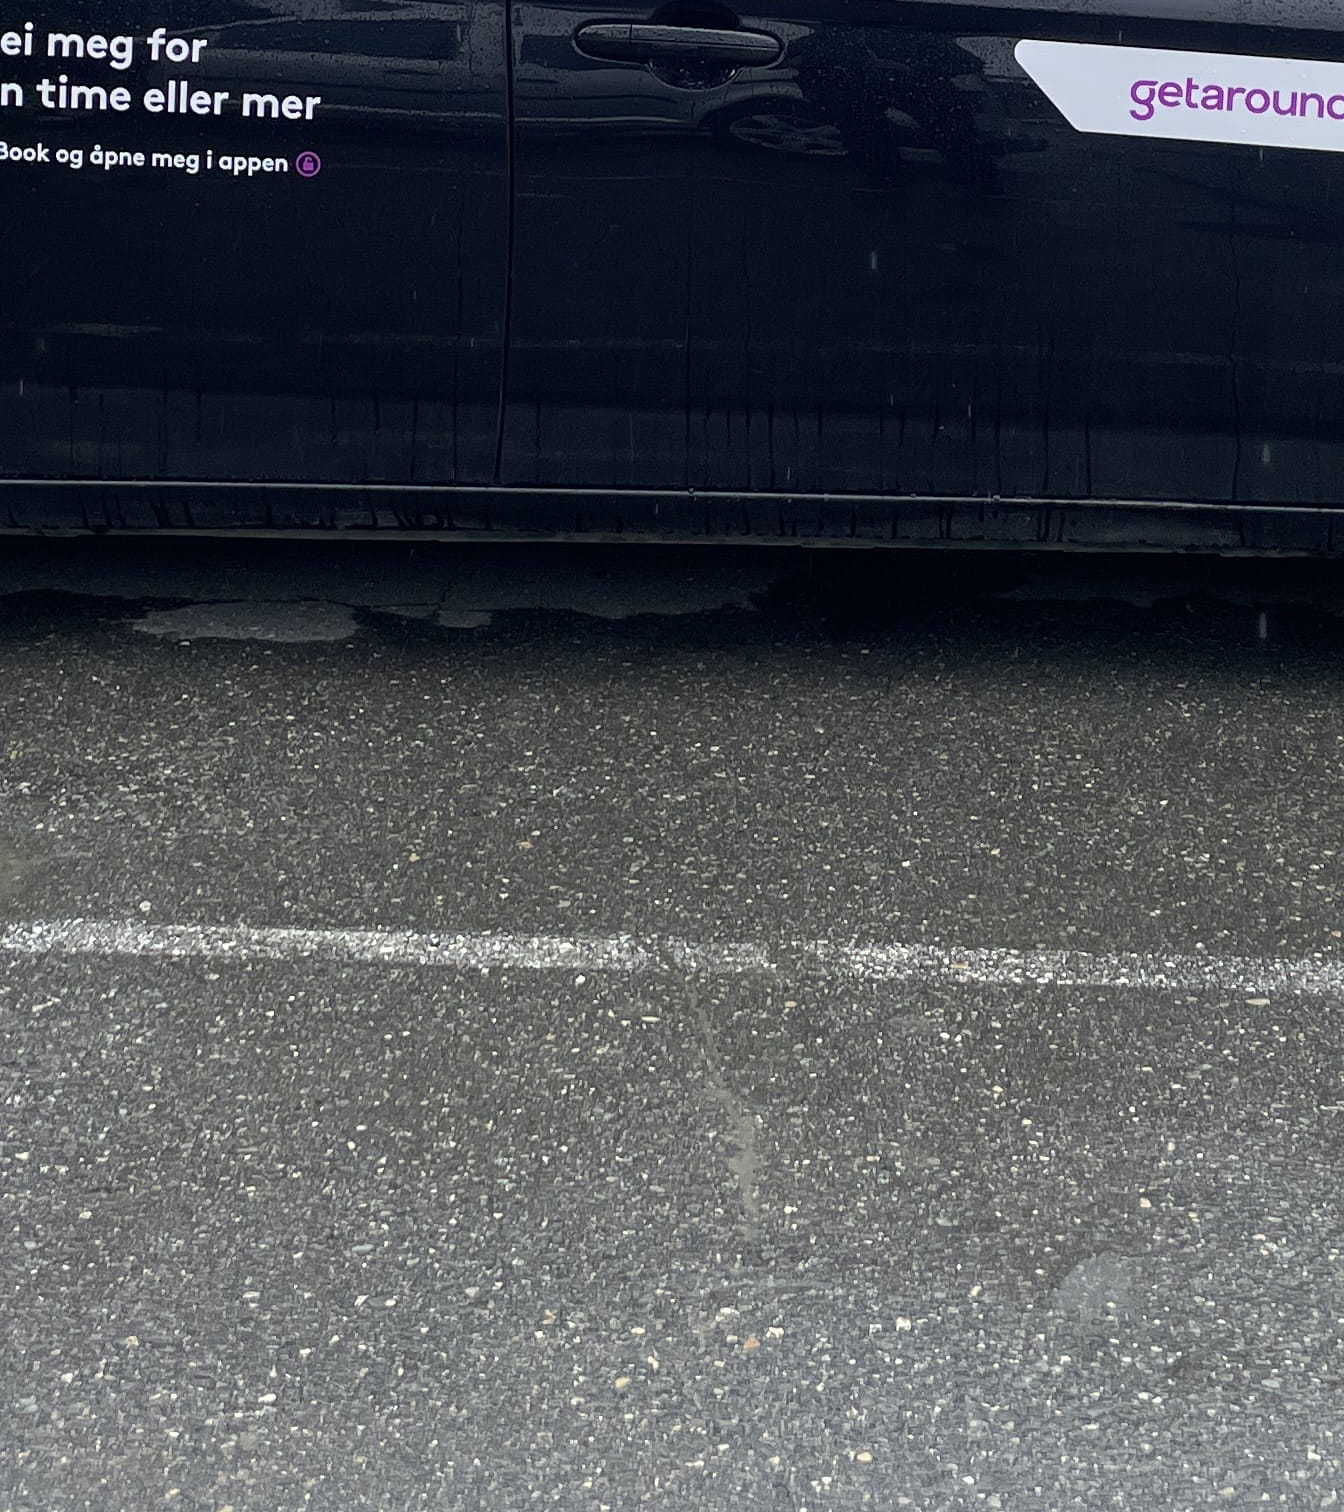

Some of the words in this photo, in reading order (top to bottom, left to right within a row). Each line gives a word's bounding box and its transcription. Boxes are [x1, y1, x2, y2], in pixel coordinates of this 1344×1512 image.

[46, 32, 134, 70] meg
[146, 28, 208, 64] for
[35, 74, 132, 112] time
[143, 80, 229, 116] eller
[242, 93, 322, 121] mer
[56, 149, 84, 169] og
[89, 144, 146, 171] åpne
[151, 154, 200, 174] meg
[206, 150, 213, 170] i
[218, 155, 289, 177] appen
